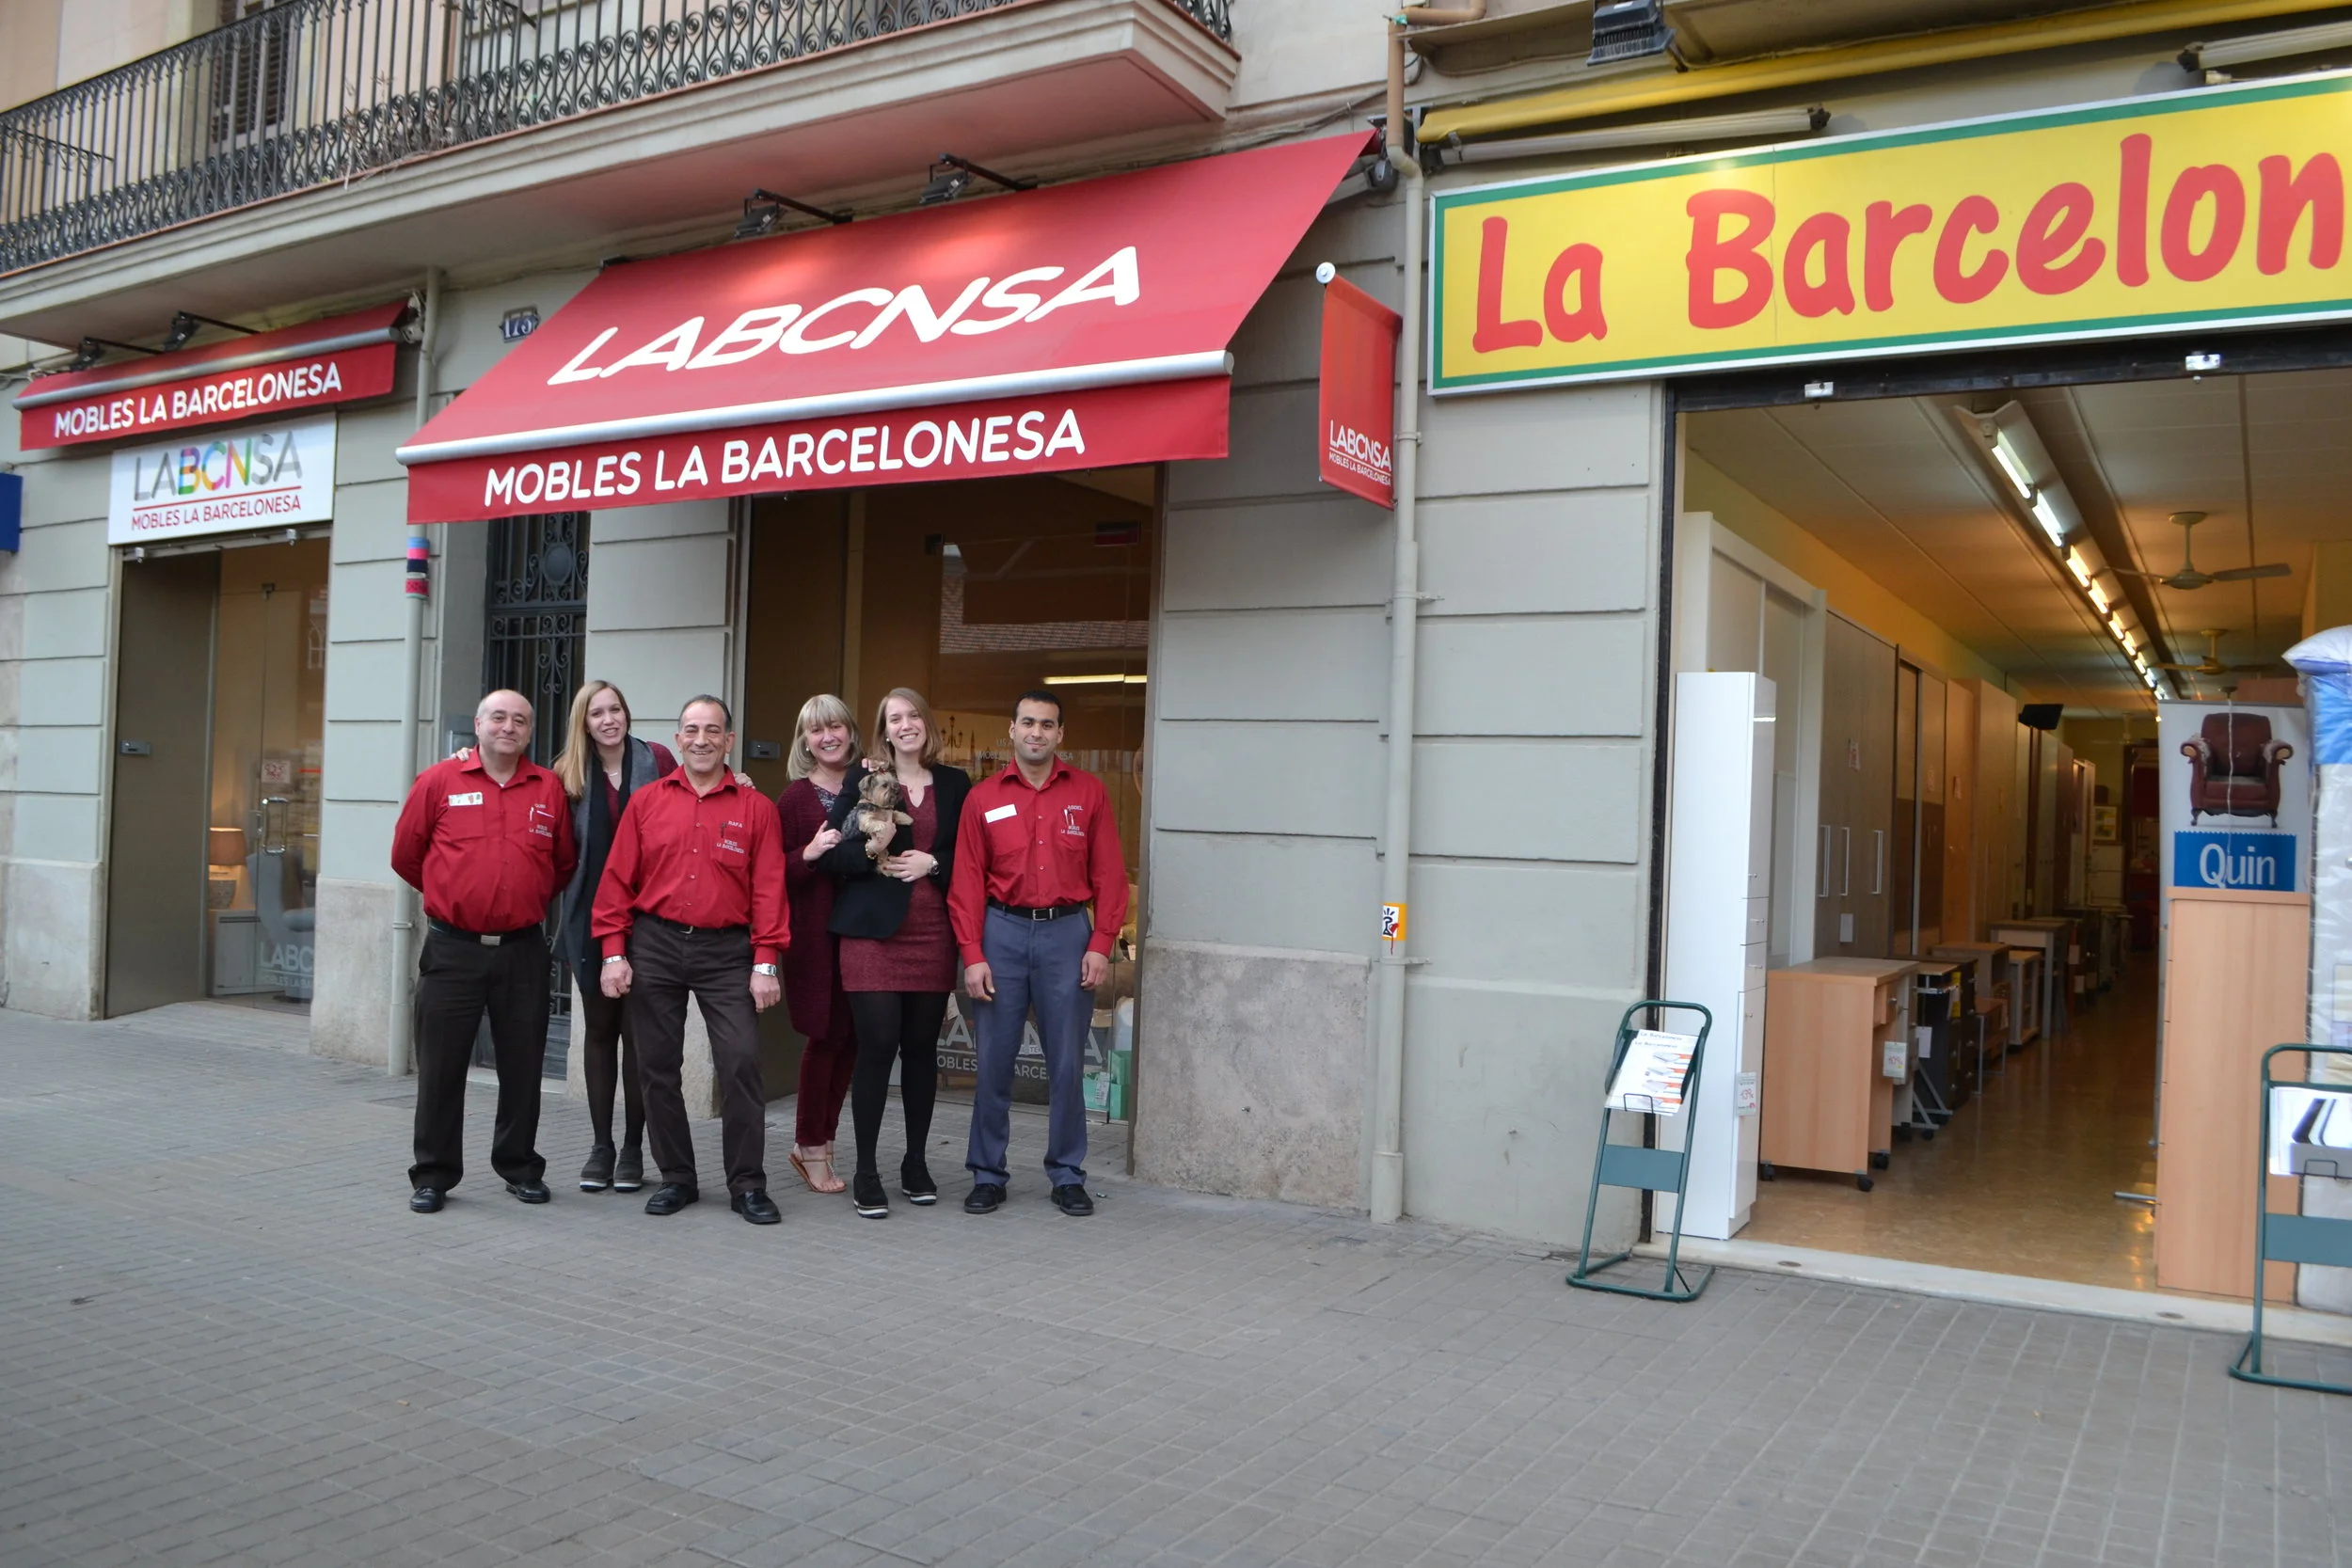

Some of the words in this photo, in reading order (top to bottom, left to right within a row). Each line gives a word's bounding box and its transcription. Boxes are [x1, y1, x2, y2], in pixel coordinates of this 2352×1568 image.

[1471, 216, 1608, 355] La
[1685, 133, 2344, 329] Barcelon
[547, 245, 1140, 387] LABCNSA
[55, 399, 135, 438] MOBLES
[138, 393, 167, 425] LA
[172, 362, 342, 420] BARCELONESA
[134, 429, 303, 501] LABCNSA
[484, 451, 642, 507] MOBLES
[654, 445, 708, 491] LA
[721, 408, 1086, 484] BARCELONESA
[1328, 451, 1350, 468] MOBLES
[1349, 461, 1357, 472] LA
[1329, 420, 1391, 472] LABCNSA
[132, 509, 181, 531] MOBLES
[183, 508, 199, 525] LA
[203, 495, 302, 522] BARCELONESA
[2199, 843, 2277, 889] Quin
[260, 941, 314, 974] LABC
[936, 1054, 978, 1072] OBLES
